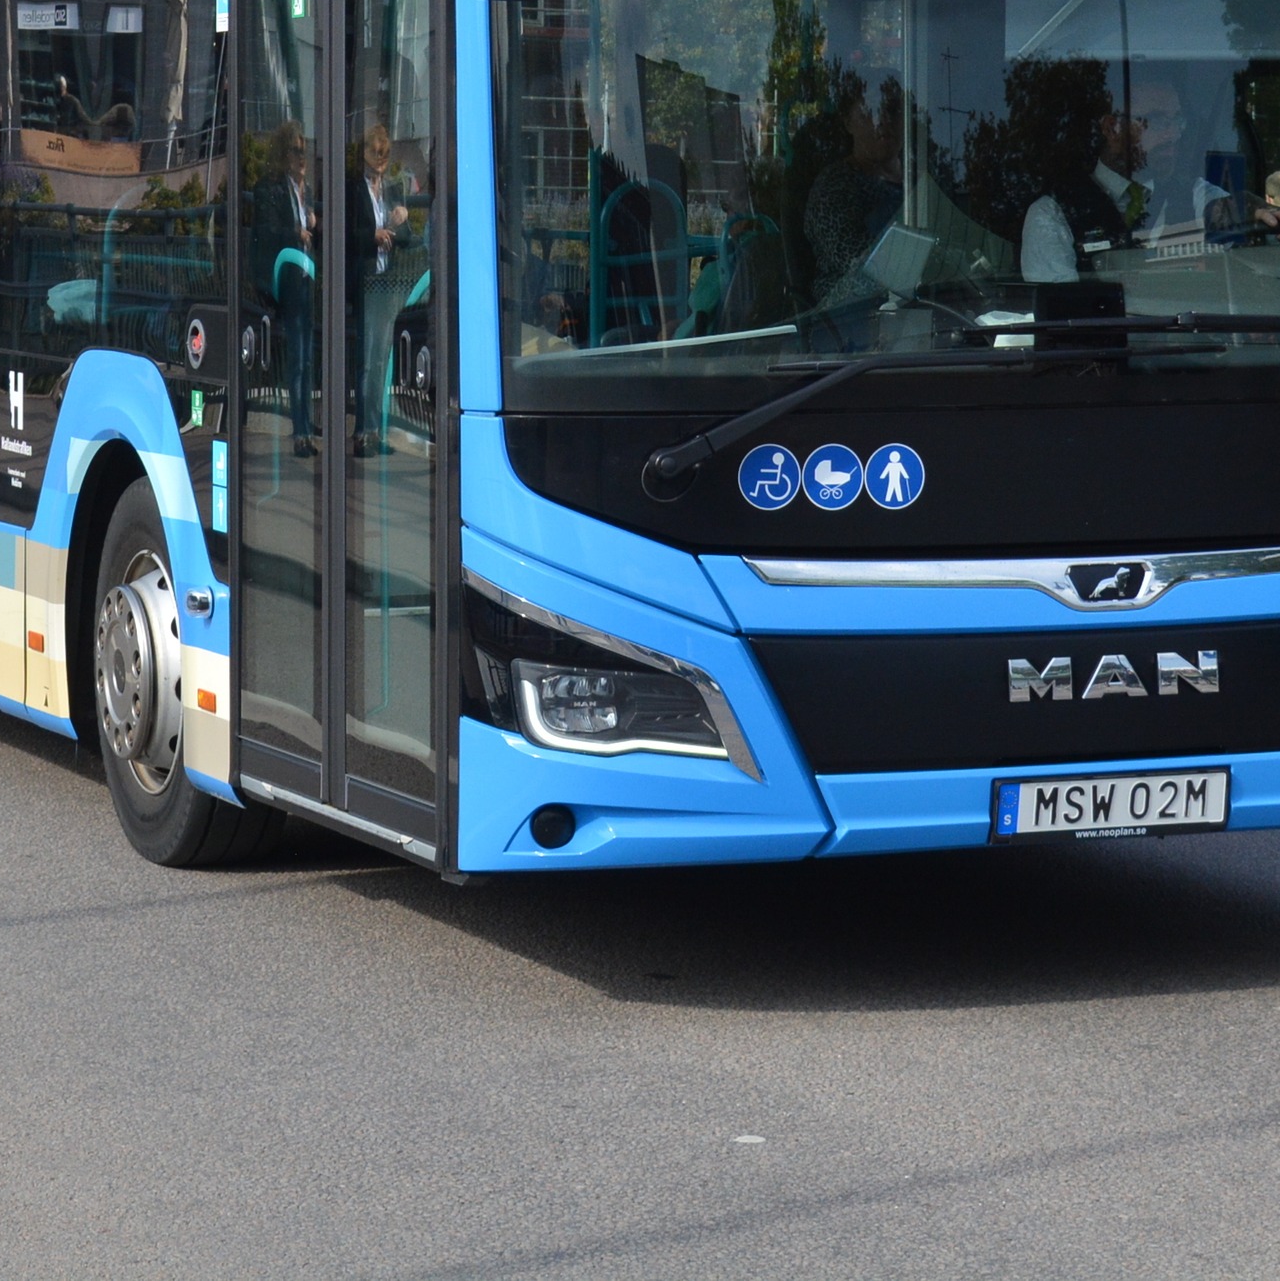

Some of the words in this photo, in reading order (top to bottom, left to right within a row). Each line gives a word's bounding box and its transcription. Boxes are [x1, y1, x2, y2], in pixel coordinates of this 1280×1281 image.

[1008, 649, 1220, 702] MAN
[1003, 814, 1012, 826] S
[1033, 784, 1116, 826] MSW
[1128, 777, 1209, 819] 02M
[1075, 826, 1147, 839] www.neoplan.se
